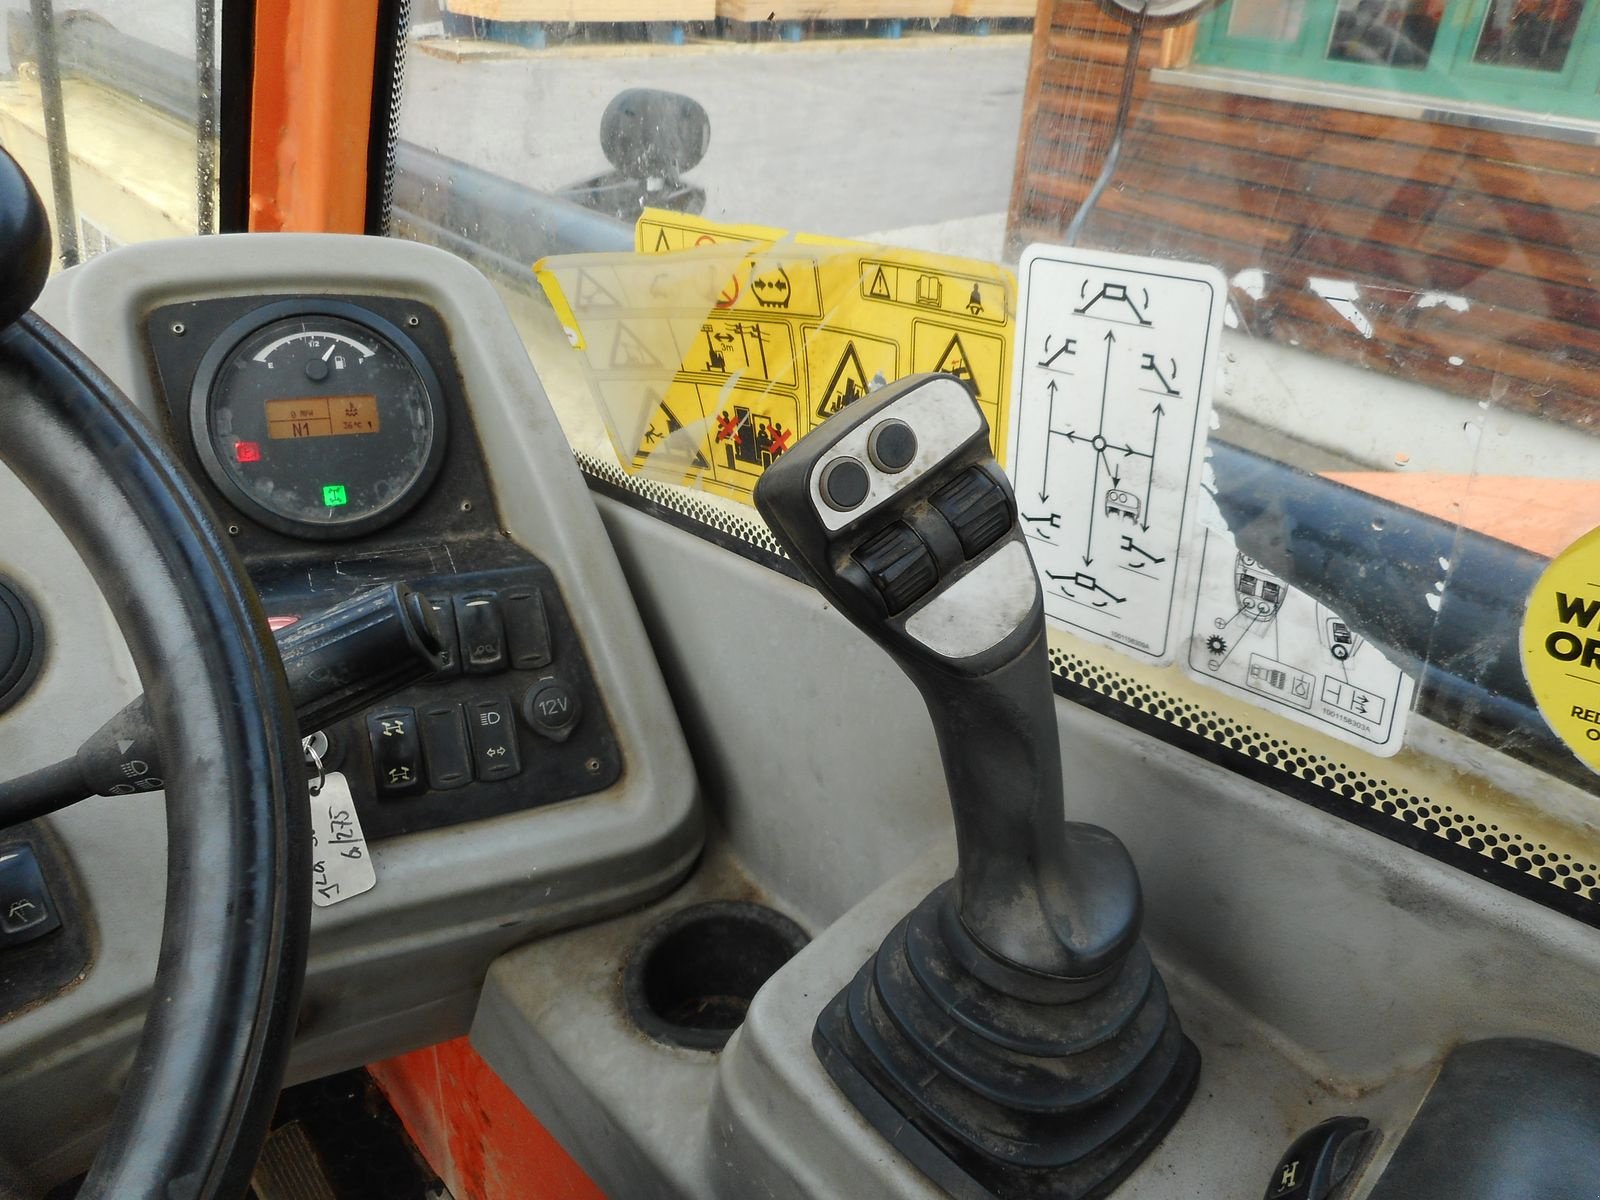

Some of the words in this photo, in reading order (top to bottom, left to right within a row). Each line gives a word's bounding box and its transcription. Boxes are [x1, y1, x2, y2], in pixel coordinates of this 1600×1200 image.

[720, 342, 734, 352] 3m
[292, 422, 310, 437] N1
[1555, 591, 1600, 632] W
[538, 696, 567, 716] 12V
